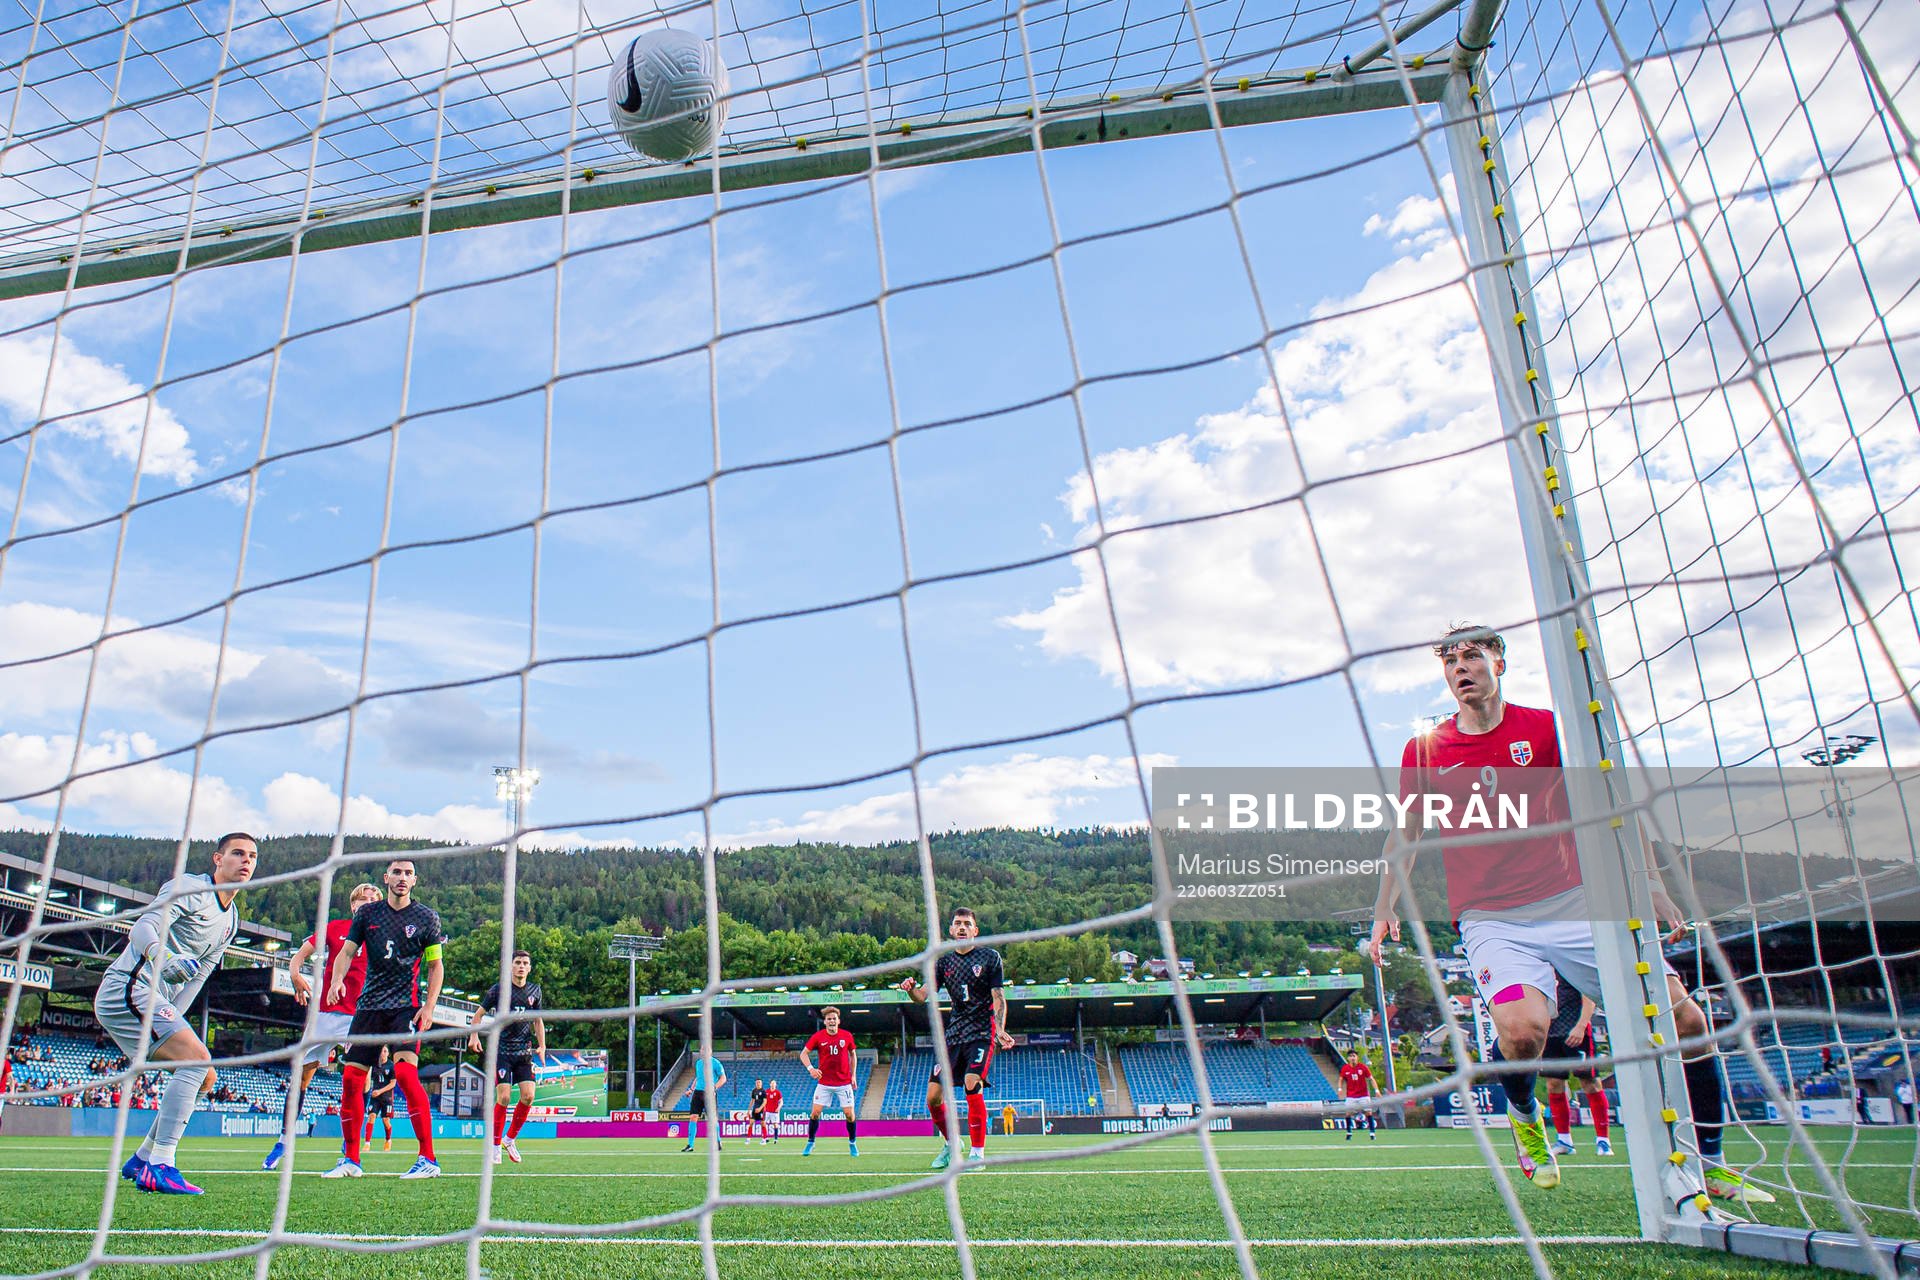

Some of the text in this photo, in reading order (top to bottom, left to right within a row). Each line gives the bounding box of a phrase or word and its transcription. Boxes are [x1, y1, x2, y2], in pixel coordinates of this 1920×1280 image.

[1481, 766, 1498, 797] 9
[384, 940, 394, 959] 5
[0, 963, 51, 985] TAION
[829, 1045, 839, 1055] 16
[975, 1048, 985, 1063] 3
[221, 1114, 254, 1136] Equinor
[613, 1112, 643, 1121] RVS AS
